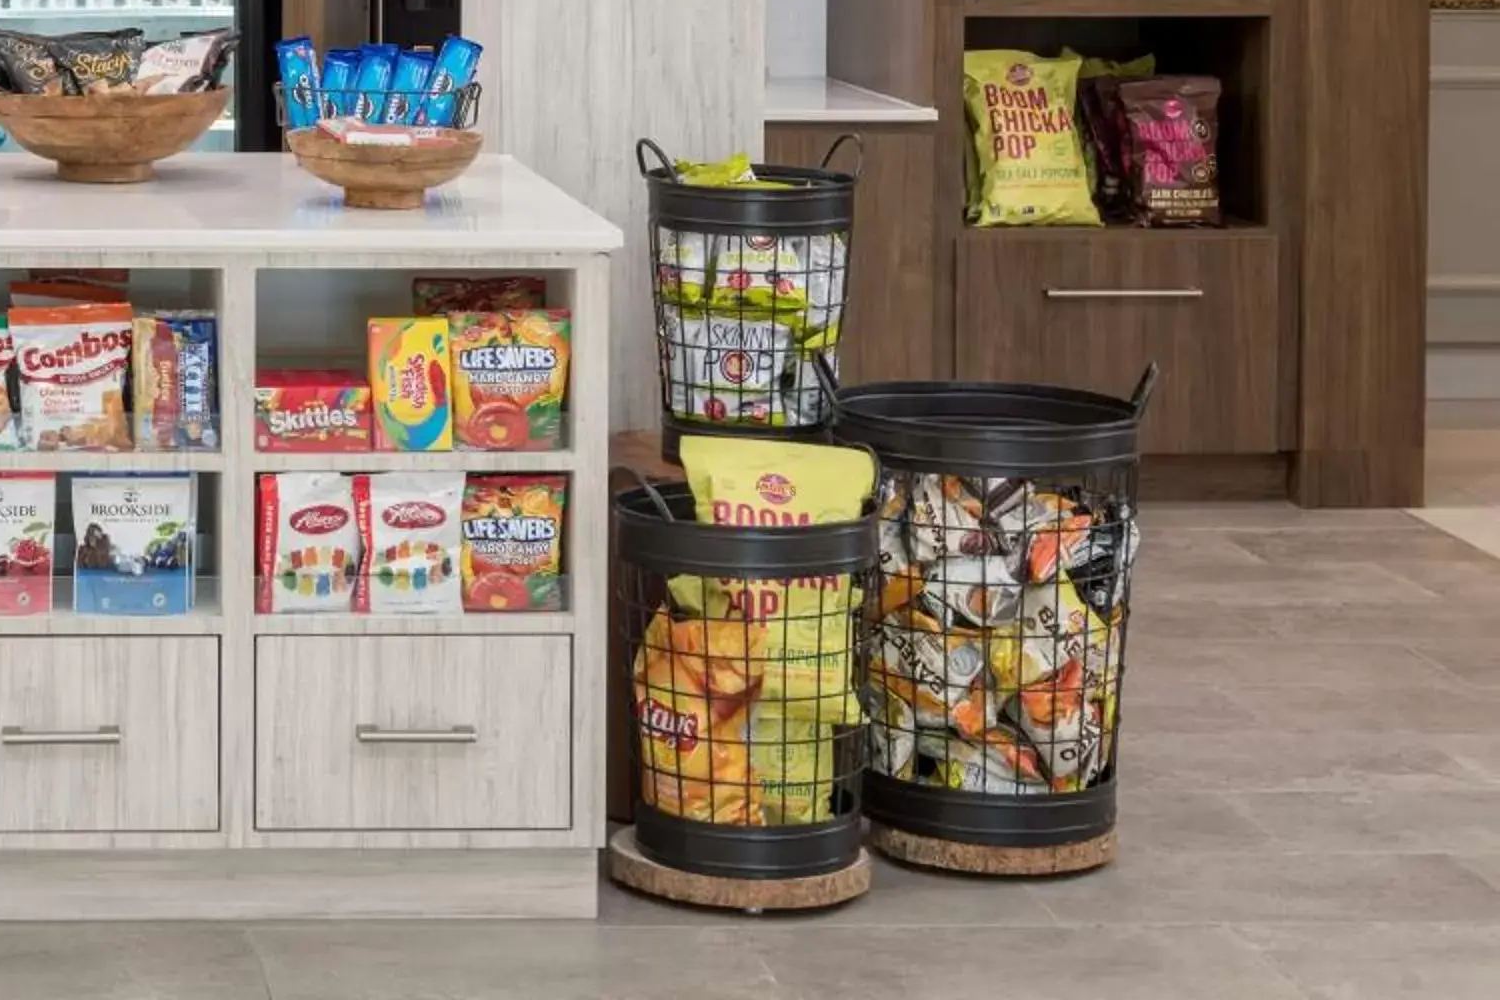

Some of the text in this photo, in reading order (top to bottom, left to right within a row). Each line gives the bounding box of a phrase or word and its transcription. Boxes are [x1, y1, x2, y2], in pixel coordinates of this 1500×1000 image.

[985, 83, 1049, 110] BOOM
[990, 110, 1072, 135] CHICKA
[993, 134, 1038, 161] POP
[23, 327, 133, 373] Combos
[462, 346, 556, 370] LIFE SAVERS
[269, 402, 357, 434] Skittles
[90, 503, 173, 517] BROOKSIDE
[463, 517, 556, 540] LIFE SAVERS
